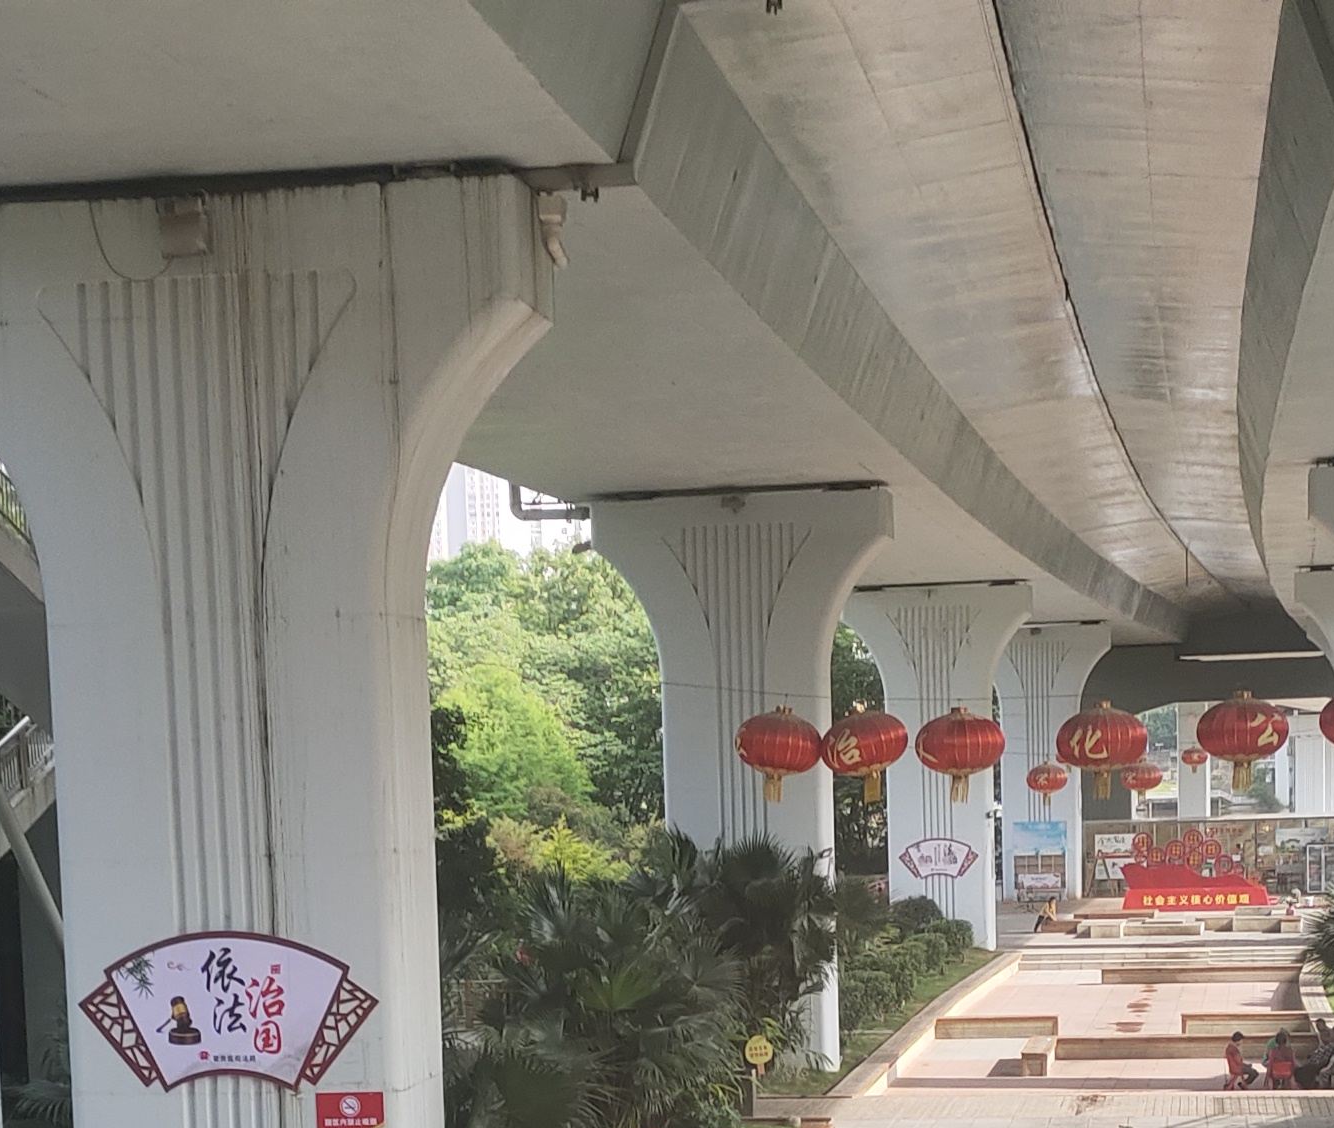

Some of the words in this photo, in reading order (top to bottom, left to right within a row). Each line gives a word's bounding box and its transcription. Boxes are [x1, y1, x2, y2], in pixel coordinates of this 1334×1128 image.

[827, 728, 861, 768] 治
[1070, 728, 1110, 759] 化
[1251, 711, 1281, 747] 公
[1142, 893, 1250, 906] 社会主义核心价值观
[201, 947, 247, 1036] 依法
[245, 976, 286, 1055] 治国
